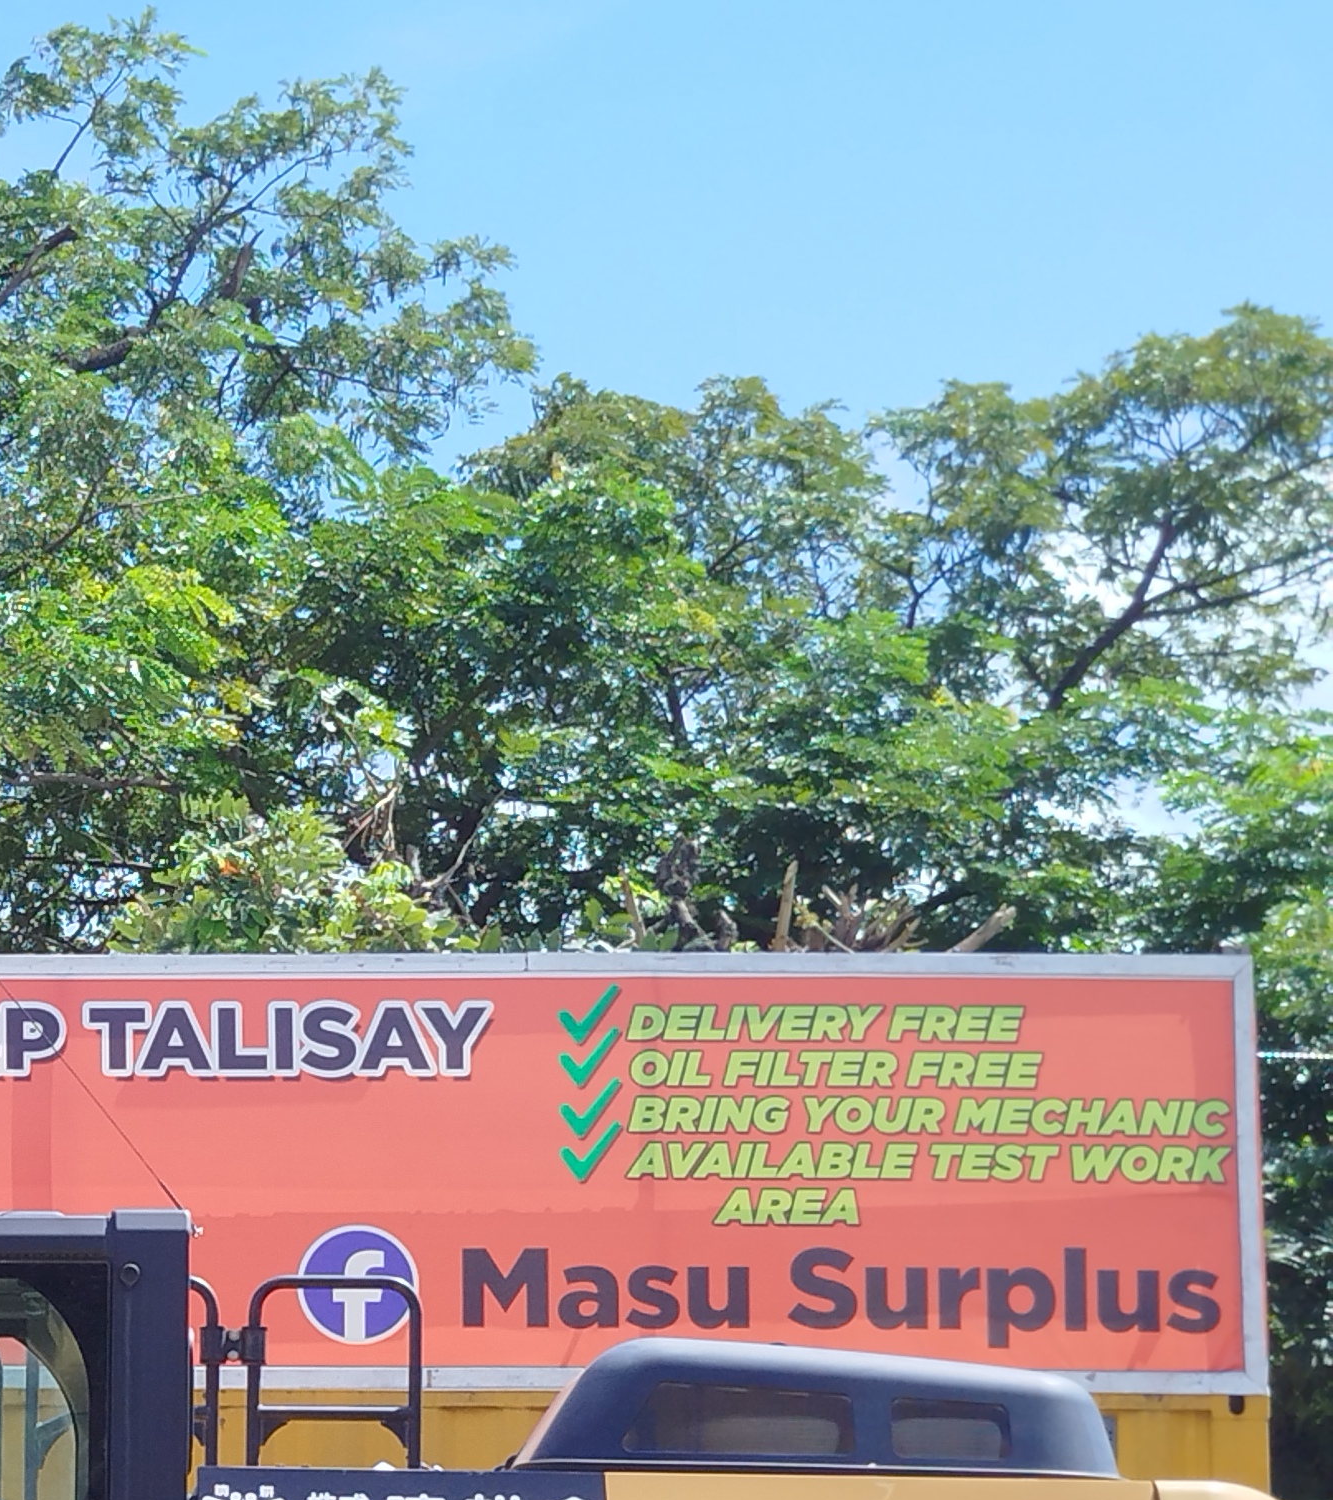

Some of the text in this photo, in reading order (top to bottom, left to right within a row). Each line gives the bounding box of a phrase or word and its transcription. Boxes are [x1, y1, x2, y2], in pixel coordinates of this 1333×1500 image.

[82, 1000, 494, 1078] TALISAY
[625, 1004, 1027, 1043] DELIVERY FREE
[630, 1051, 1044, 1090] OIL FILTER FREE
[627, 1096, 1231, 1138] BRING YOUR MECHANIC
[627, 1142, 1233, 1185] AVAILABLE TEST WORK
[713, 1188, 861, 1227] AREA
[462, 1246, 1221, 1350] Masu Surplus
